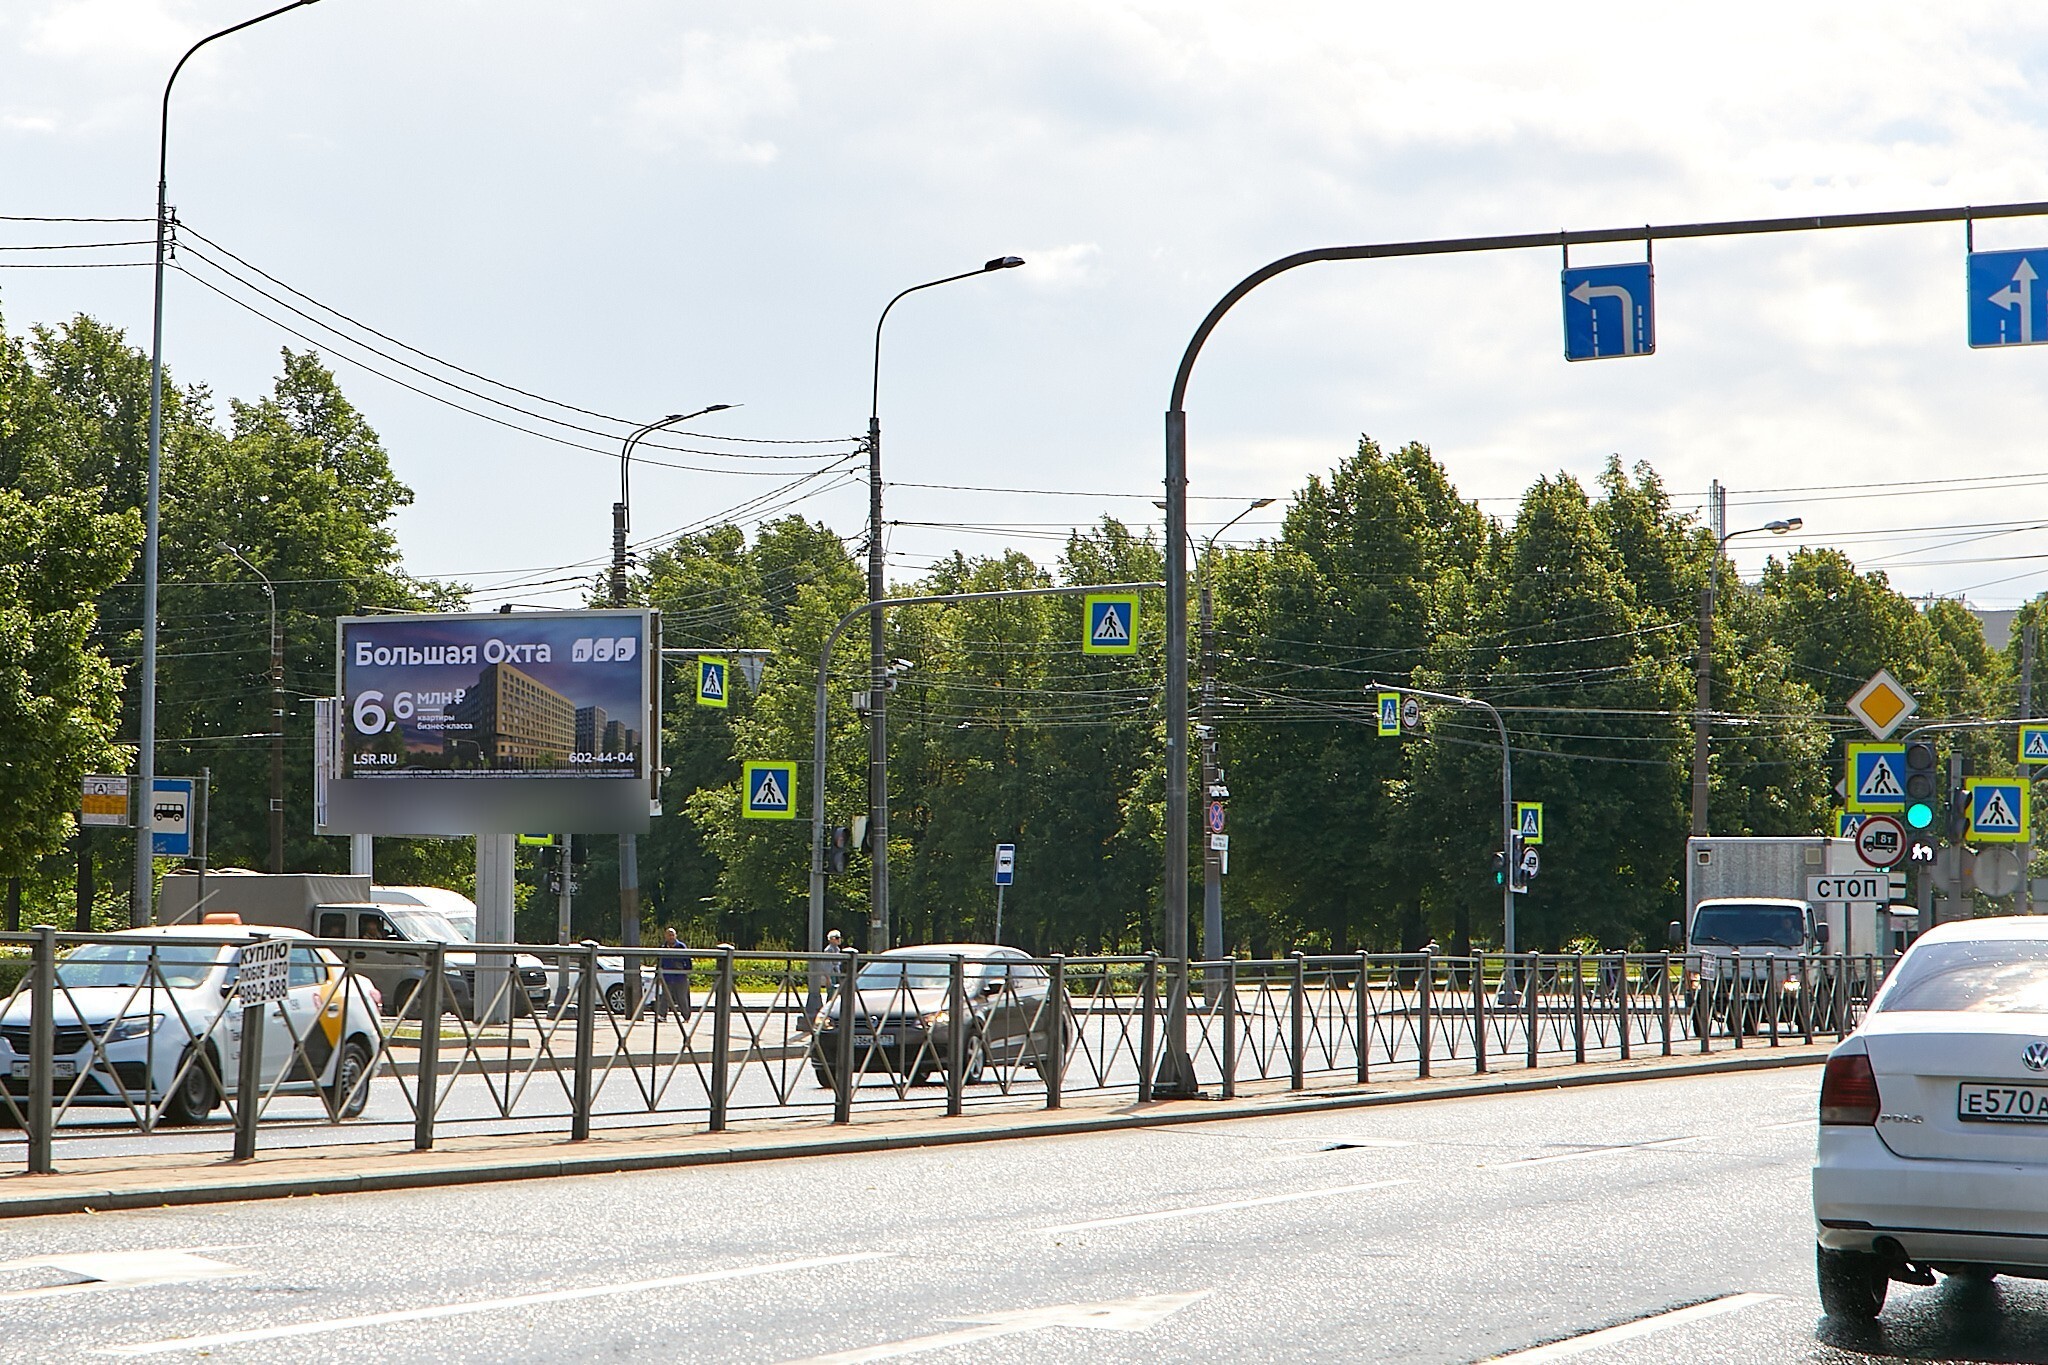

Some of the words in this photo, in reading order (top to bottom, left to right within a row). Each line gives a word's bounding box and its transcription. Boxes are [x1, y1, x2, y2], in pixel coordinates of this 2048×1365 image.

[355, 641, 477, 666] Большая
[483, 638, 551, 664] Охта
[352, 690, 414, 735] 6,6
[417, 714, 455, 722] квартиры
[416, 722, 473, 731] бизнес-класса
[353, 753, 397, 765] LSR.RU
[569, 752, 635, 763] 602-44-04
[1817, 879, 1877, 898] СТОП
[240, 942, 288, 965] КУПЛЮ
